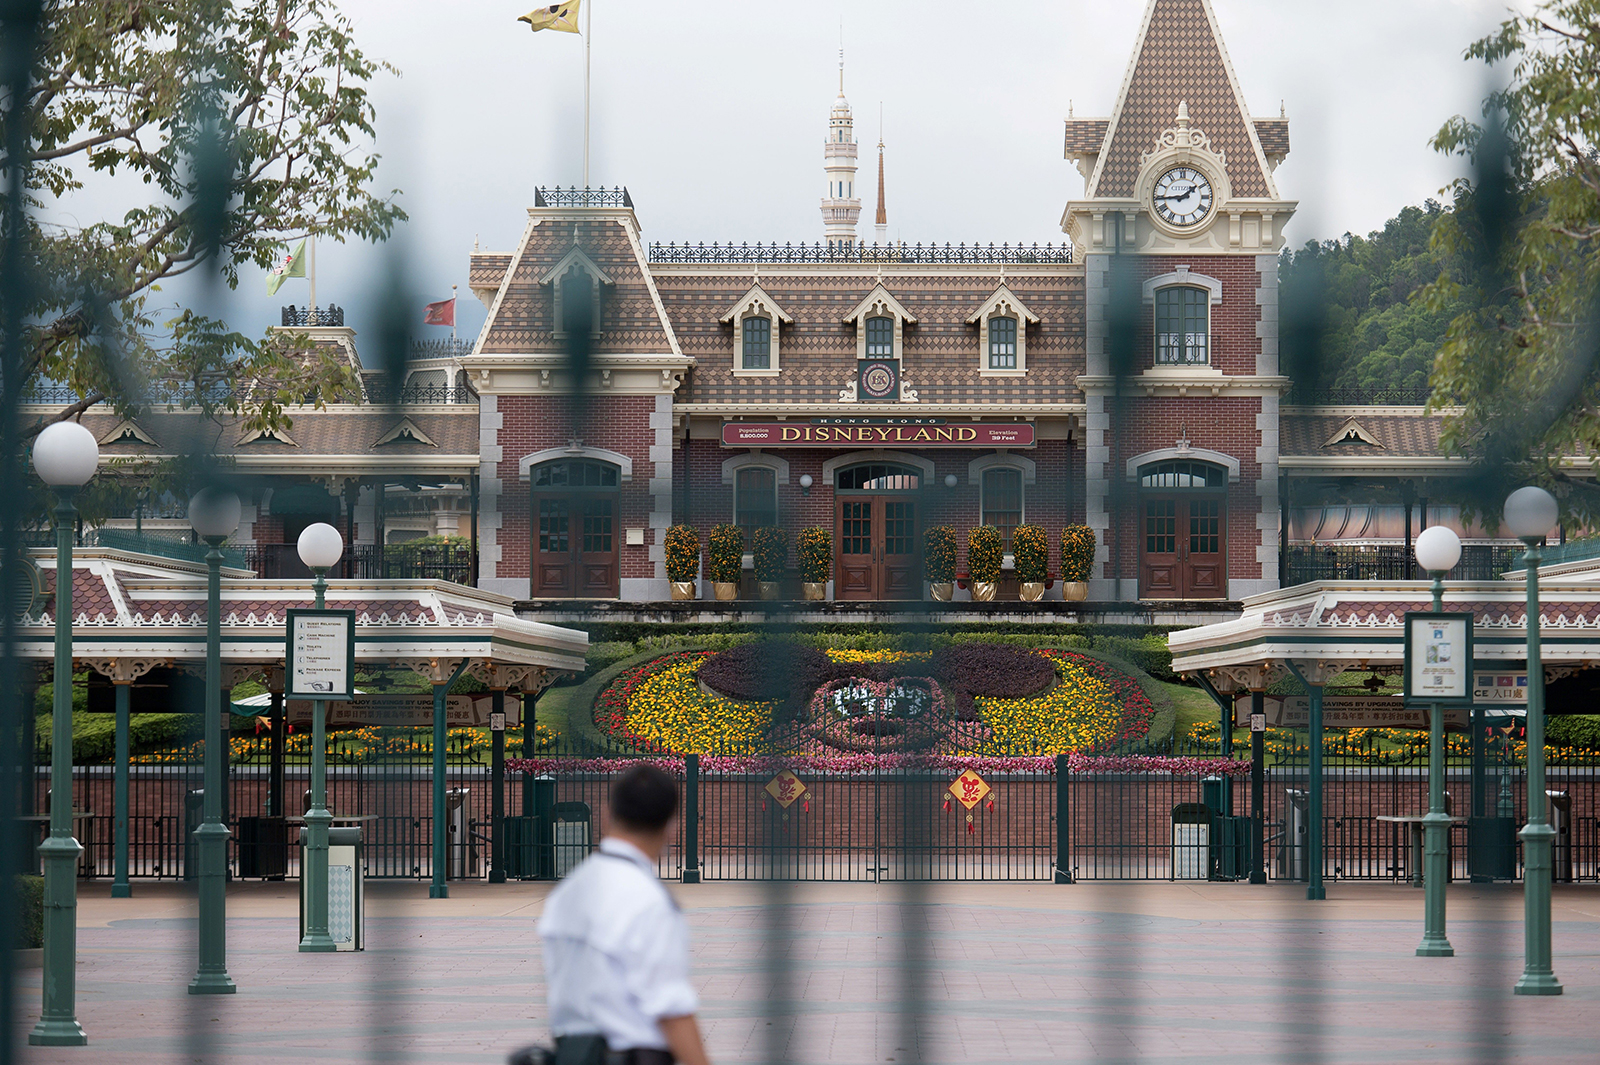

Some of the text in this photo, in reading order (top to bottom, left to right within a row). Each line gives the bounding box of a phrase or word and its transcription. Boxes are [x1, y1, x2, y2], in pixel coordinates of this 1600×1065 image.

[780, 427, 978, 441] DISNEYLAND
[1493, 688, 1523, 699] 入口處
